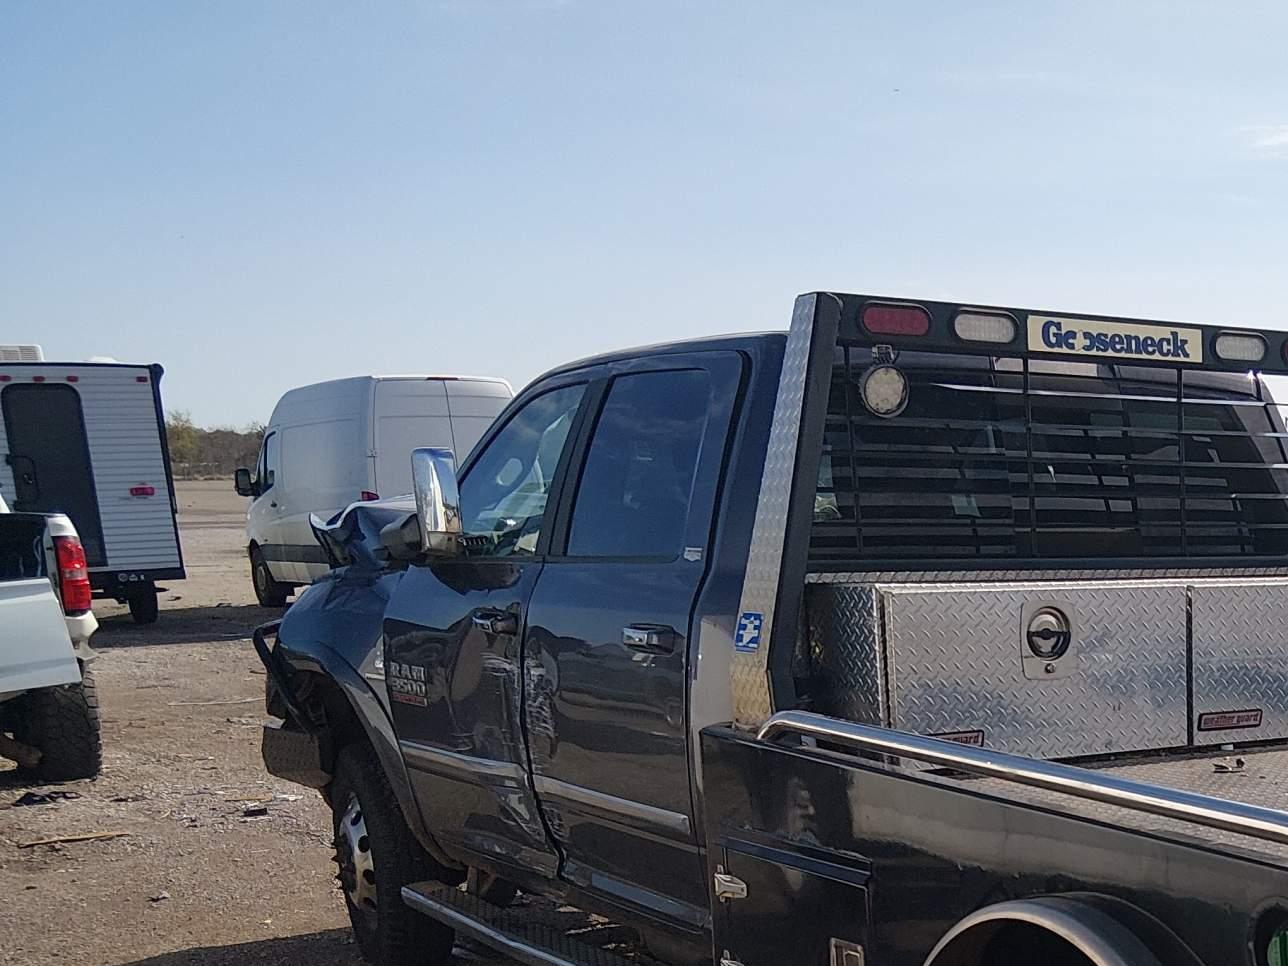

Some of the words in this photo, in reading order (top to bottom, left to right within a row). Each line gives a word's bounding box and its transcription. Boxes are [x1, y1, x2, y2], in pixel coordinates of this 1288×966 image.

[1041, 320, 1190, 358] Gooseneck
[390, 661, 425, 681] RAM
[391, 677, 426, 696] 3500
